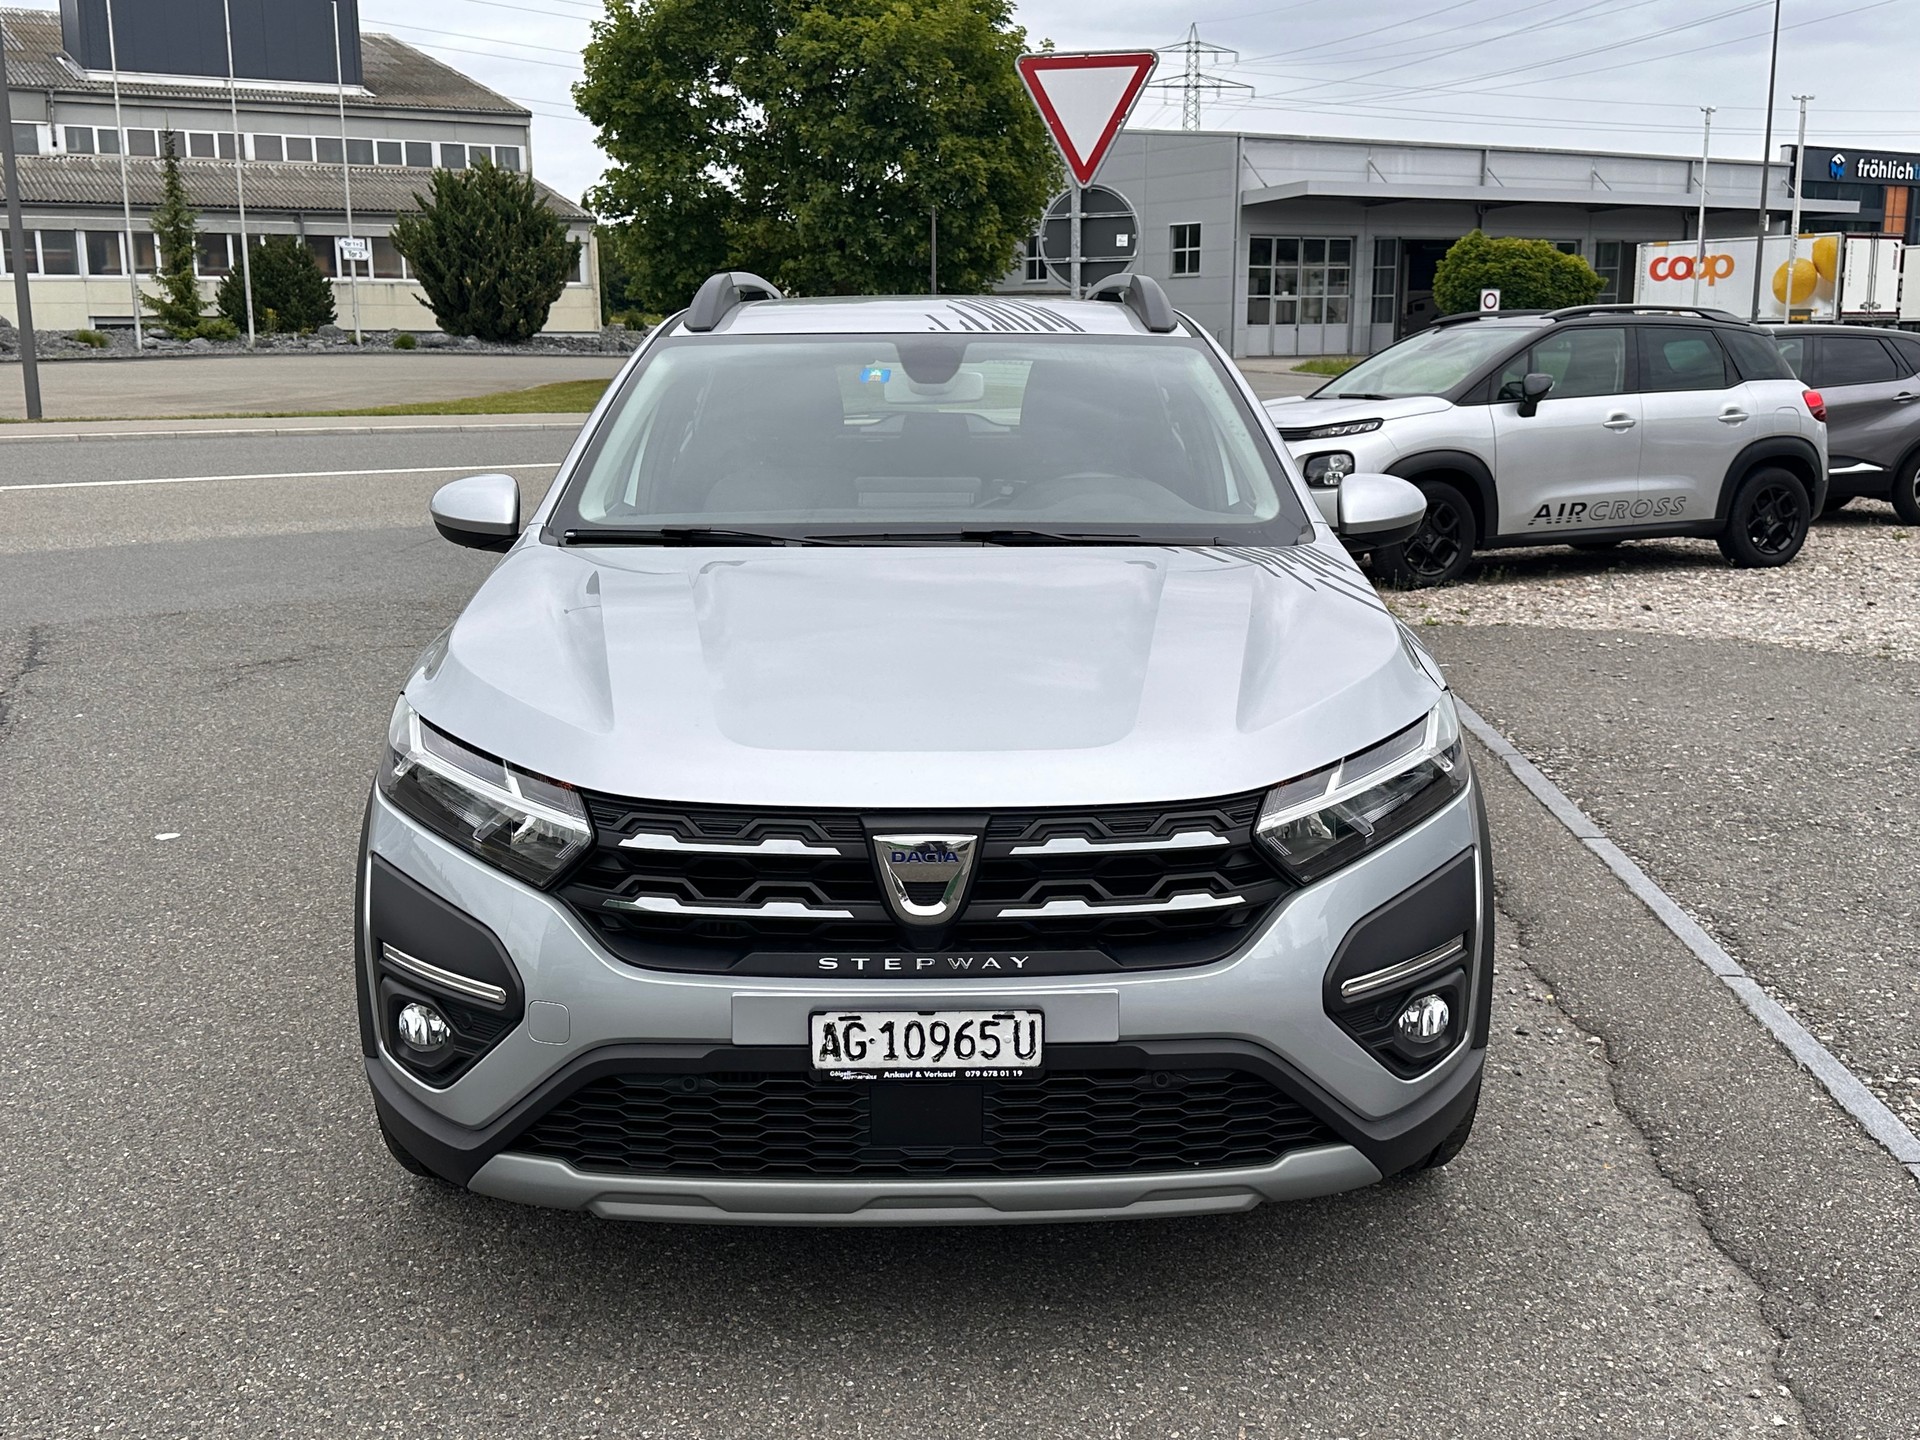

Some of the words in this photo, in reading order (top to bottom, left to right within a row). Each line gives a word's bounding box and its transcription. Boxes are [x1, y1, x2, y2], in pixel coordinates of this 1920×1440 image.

[1649, 255, 1735, 287] coop
[1528, 496, 1687, 526] AIRCROSS
[890, 851, 960, 864] DACIA
[818, 956, 1030, 971] STEPWAY
[884, 1070, 913, 1078] Ankauf
[923, 1070, 957, 1078] Verkauf
[964, 1070, 981, 1078] 079
[982, 1070, 999, 1078] 678
[999, 1070, 1010, 1078] 01
[1012, 1070, 1023, 1078] 19
